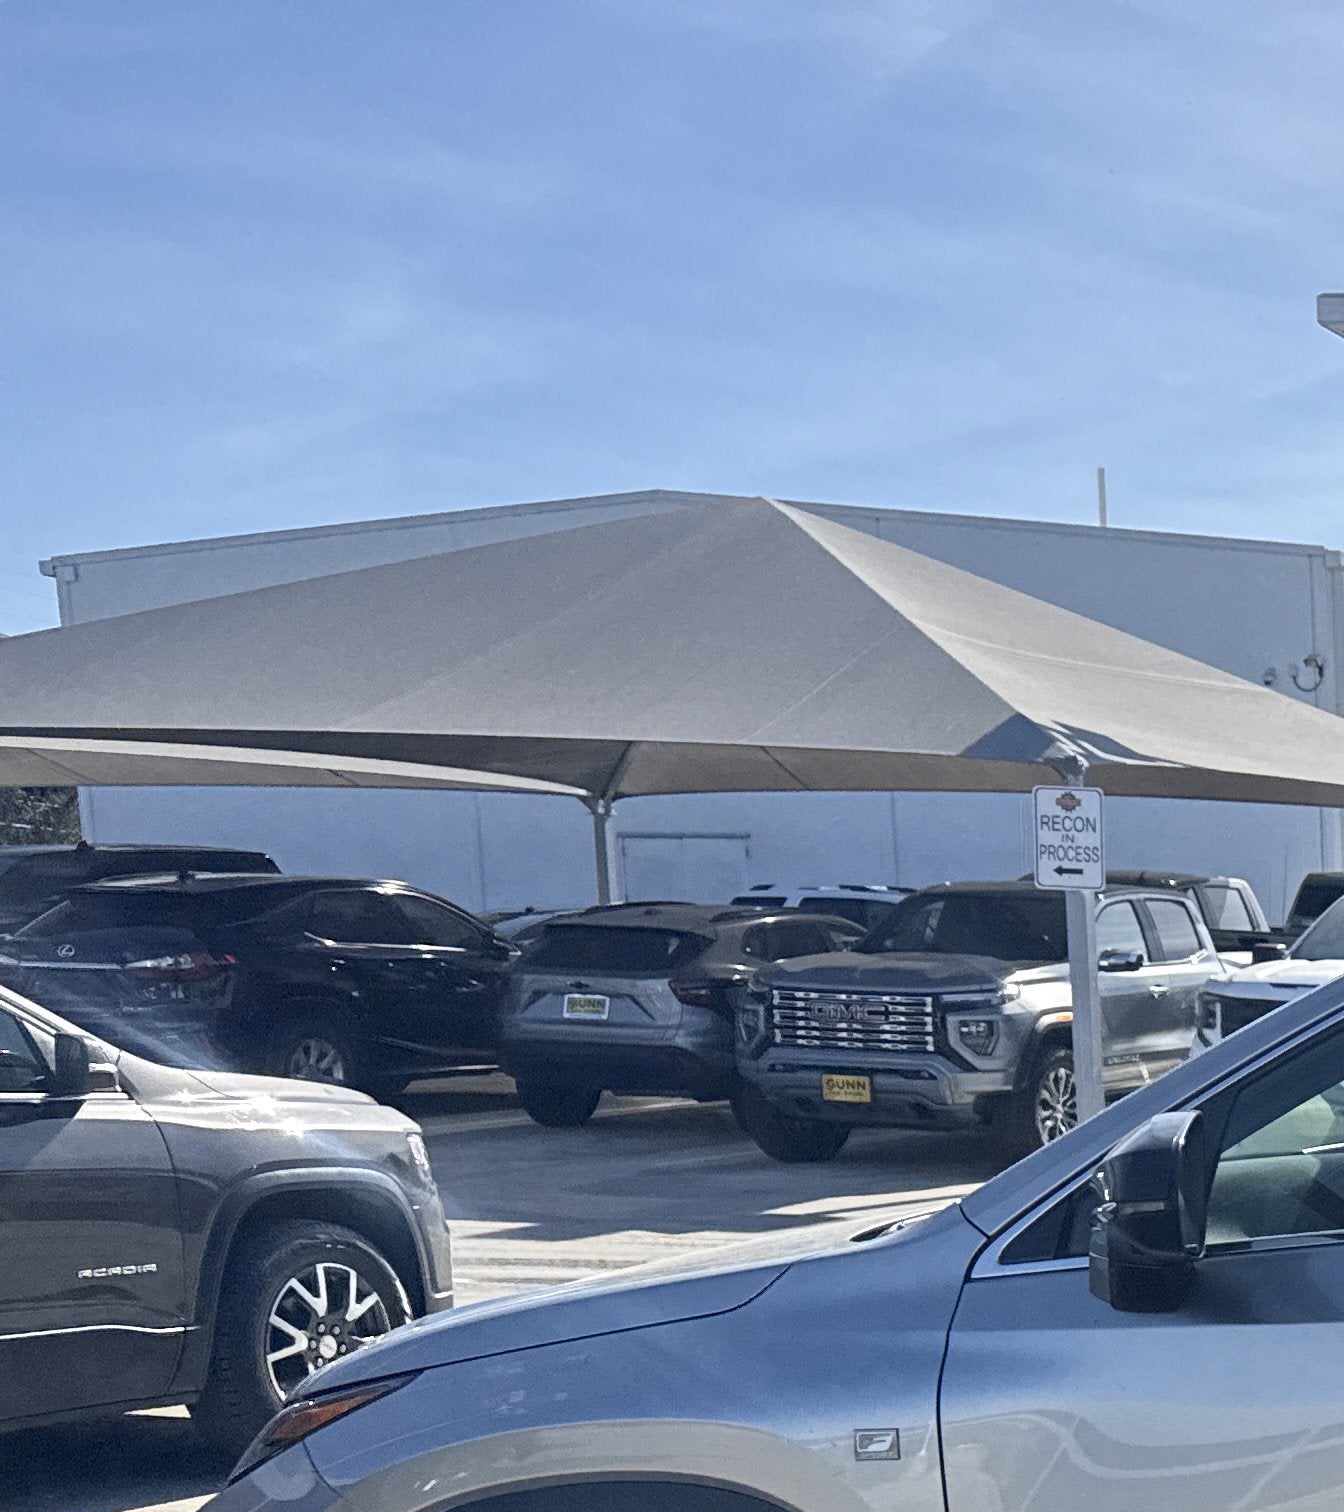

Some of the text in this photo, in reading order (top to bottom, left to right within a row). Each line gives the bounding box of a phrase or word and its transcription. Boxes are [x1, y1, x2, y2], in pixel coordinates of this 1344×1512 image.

[1040, 814, 1097, 833] RECON
[1061, 833, 1075, 843] IN
[1039, 844, 1100, 863] PROCESS
[811, 1002, 886, 1023] GMC
[826, 1079, 866, 1090] GUNN
[77, 1263, 158, 1279] ACADIA
